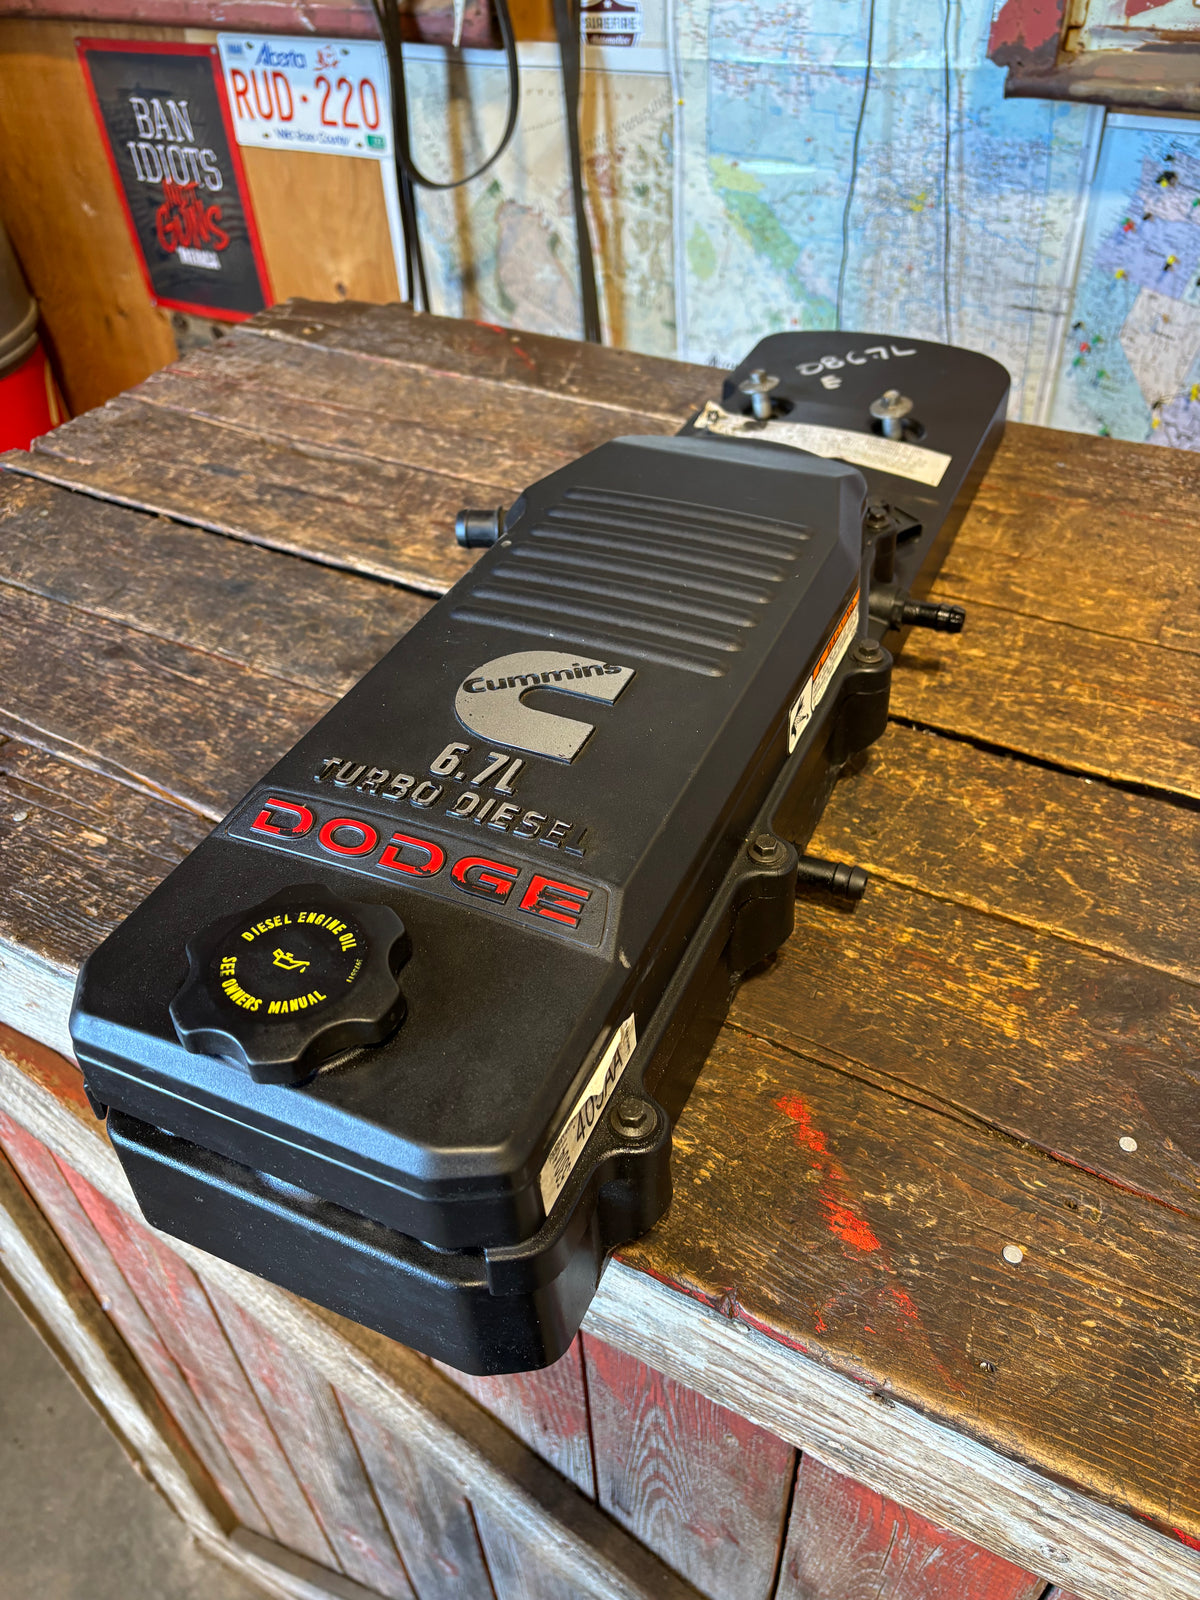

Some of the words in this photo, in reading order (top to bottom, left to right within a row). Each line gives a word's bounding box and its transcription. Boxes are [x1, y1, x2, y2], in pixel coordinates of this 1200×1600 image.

[255, 42, 307, 69] Alberta
[129, 97, 195, 143] BAN
[127, 141, 224, 191] IDIOTS
[155, 200, 231, 253] GUNS
[462, 662, 622, 693] Cummins
[429, 741, 525, 796] 6.7L
[314, 757, 444, 808] TURBO
[445, 791, 588, 857] DIESEL
[249, 797, 593, 929] DODGE
[241, 913, 292, 942] DIESEL
[297, 911, 348, 935] ENGINE
[338, 932, 357, 952] OIL
[219, 956, 238, 977] SEE
[221, 978, 263, 1012] OWNERS
[267, 990, 327, 1015] MANUAL
